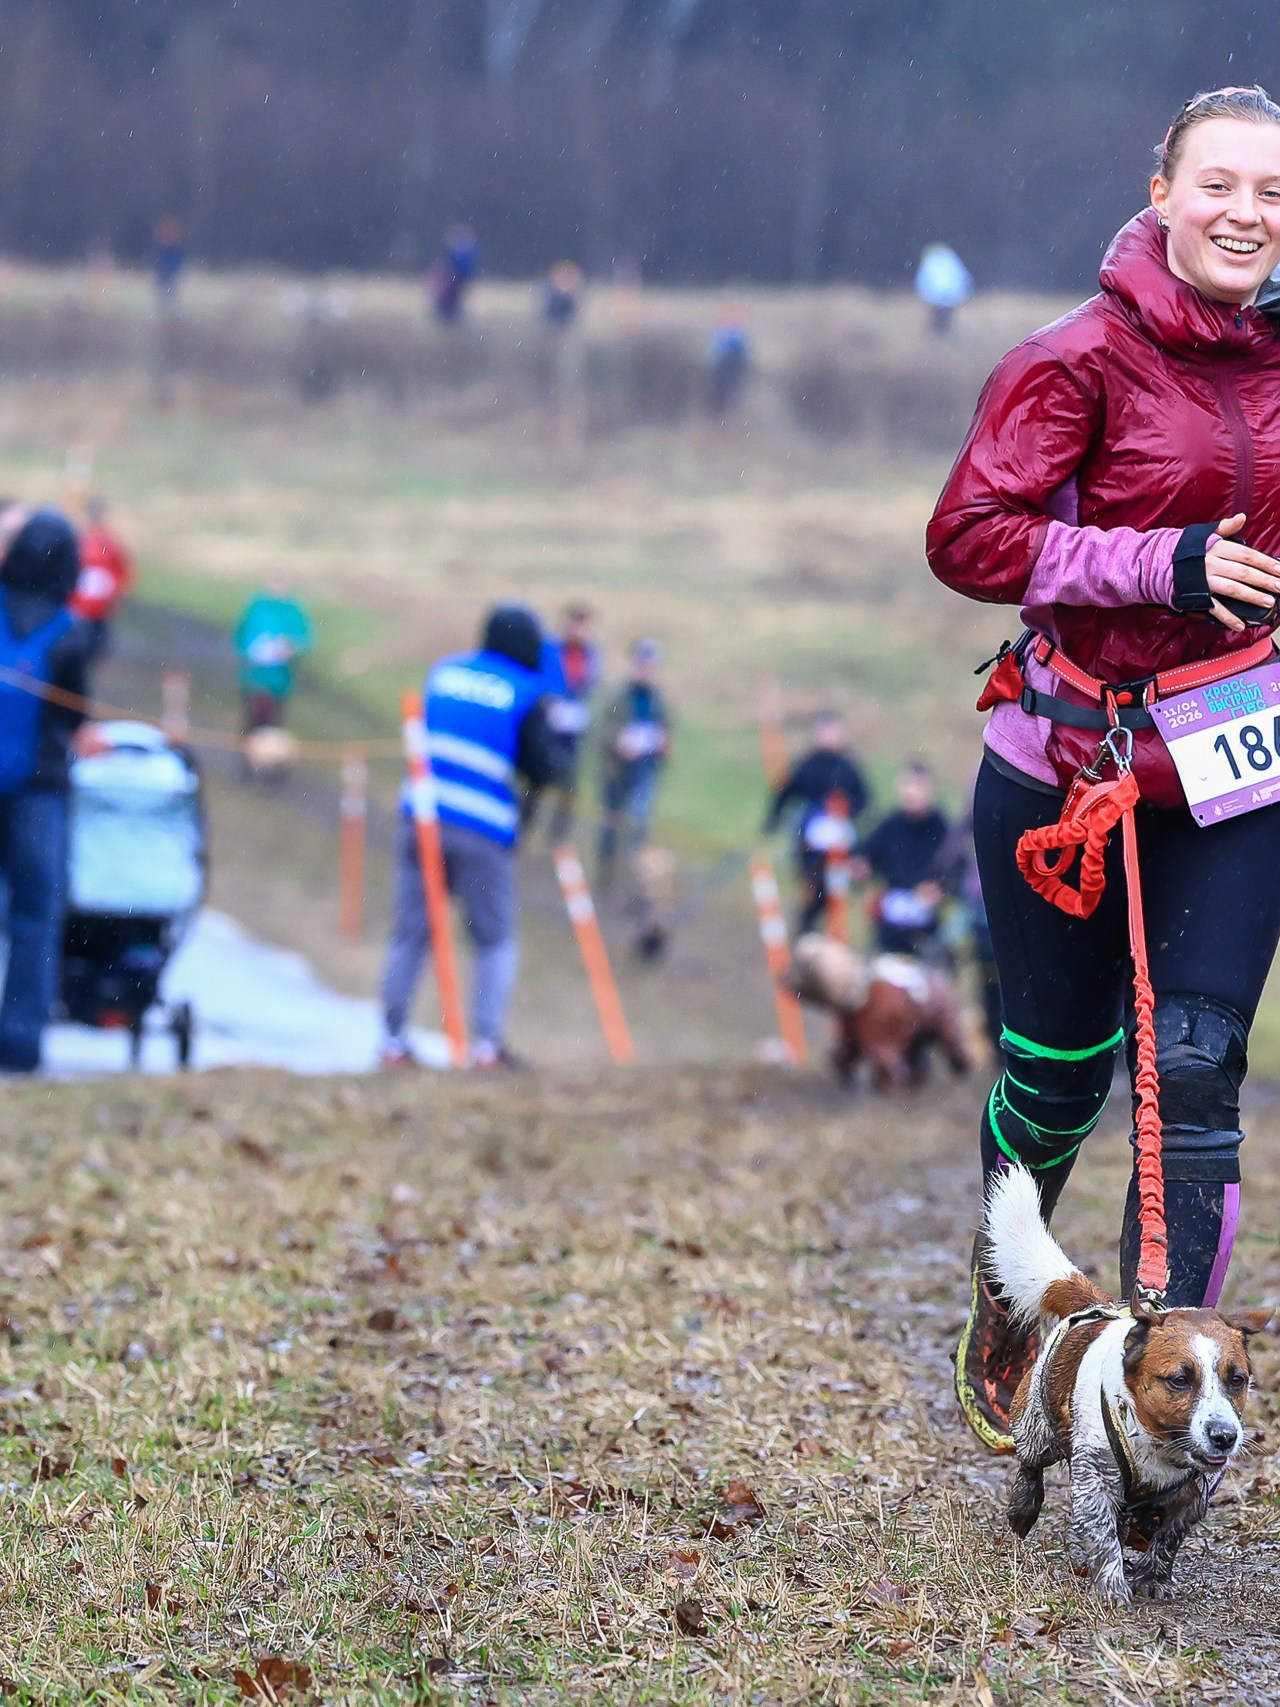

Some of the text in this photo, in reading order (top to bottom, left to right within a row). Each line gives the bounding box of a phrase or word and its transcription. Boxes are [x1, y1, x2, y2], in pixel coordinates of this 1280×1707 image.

[1203, 677, 1247, 702] КРОСС
[1270, 682, 1279, 693] 2
[1207, 682, 1263, 713] БЫСТРЫЙ
[1162, 700, 1199, 718] 11/04
[1168, 711, 1203, 729] 2026
